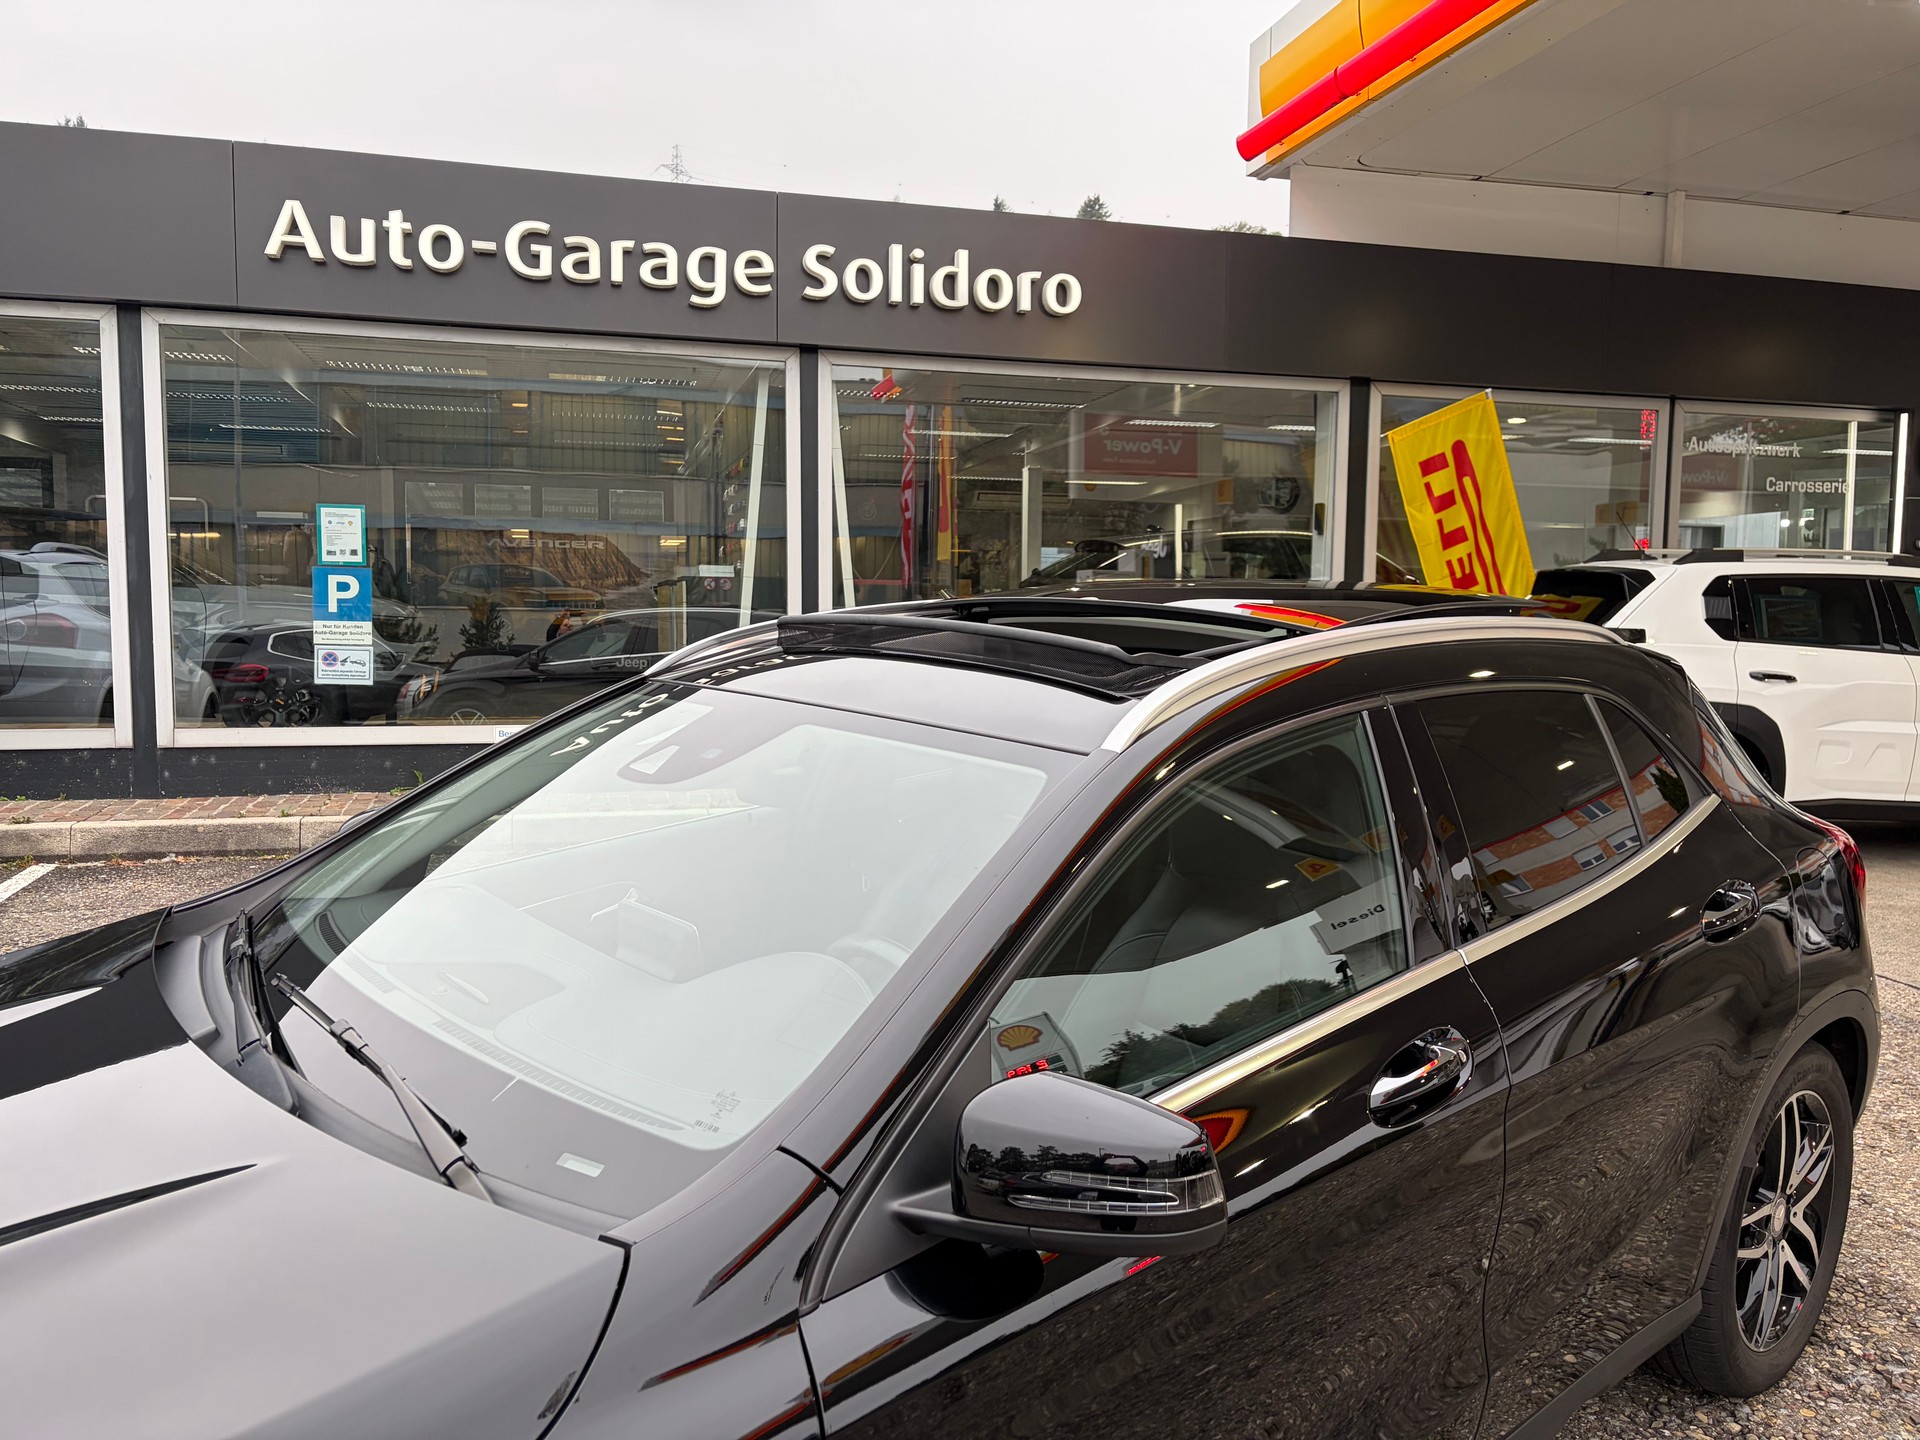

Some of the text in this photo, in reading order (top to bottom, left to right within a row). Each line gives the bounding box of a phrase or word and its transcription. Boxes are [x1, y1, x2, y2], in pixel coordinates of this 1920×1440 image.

[263, 198, 1083, 317] Auto-Garage Solidoro
[1765, 476, 1850, 494] Carrosserie
[487, 538, 606, 550] AVENGER
[327, 574, 360, 613] P
[615, 656, 648, 669] Jeep
